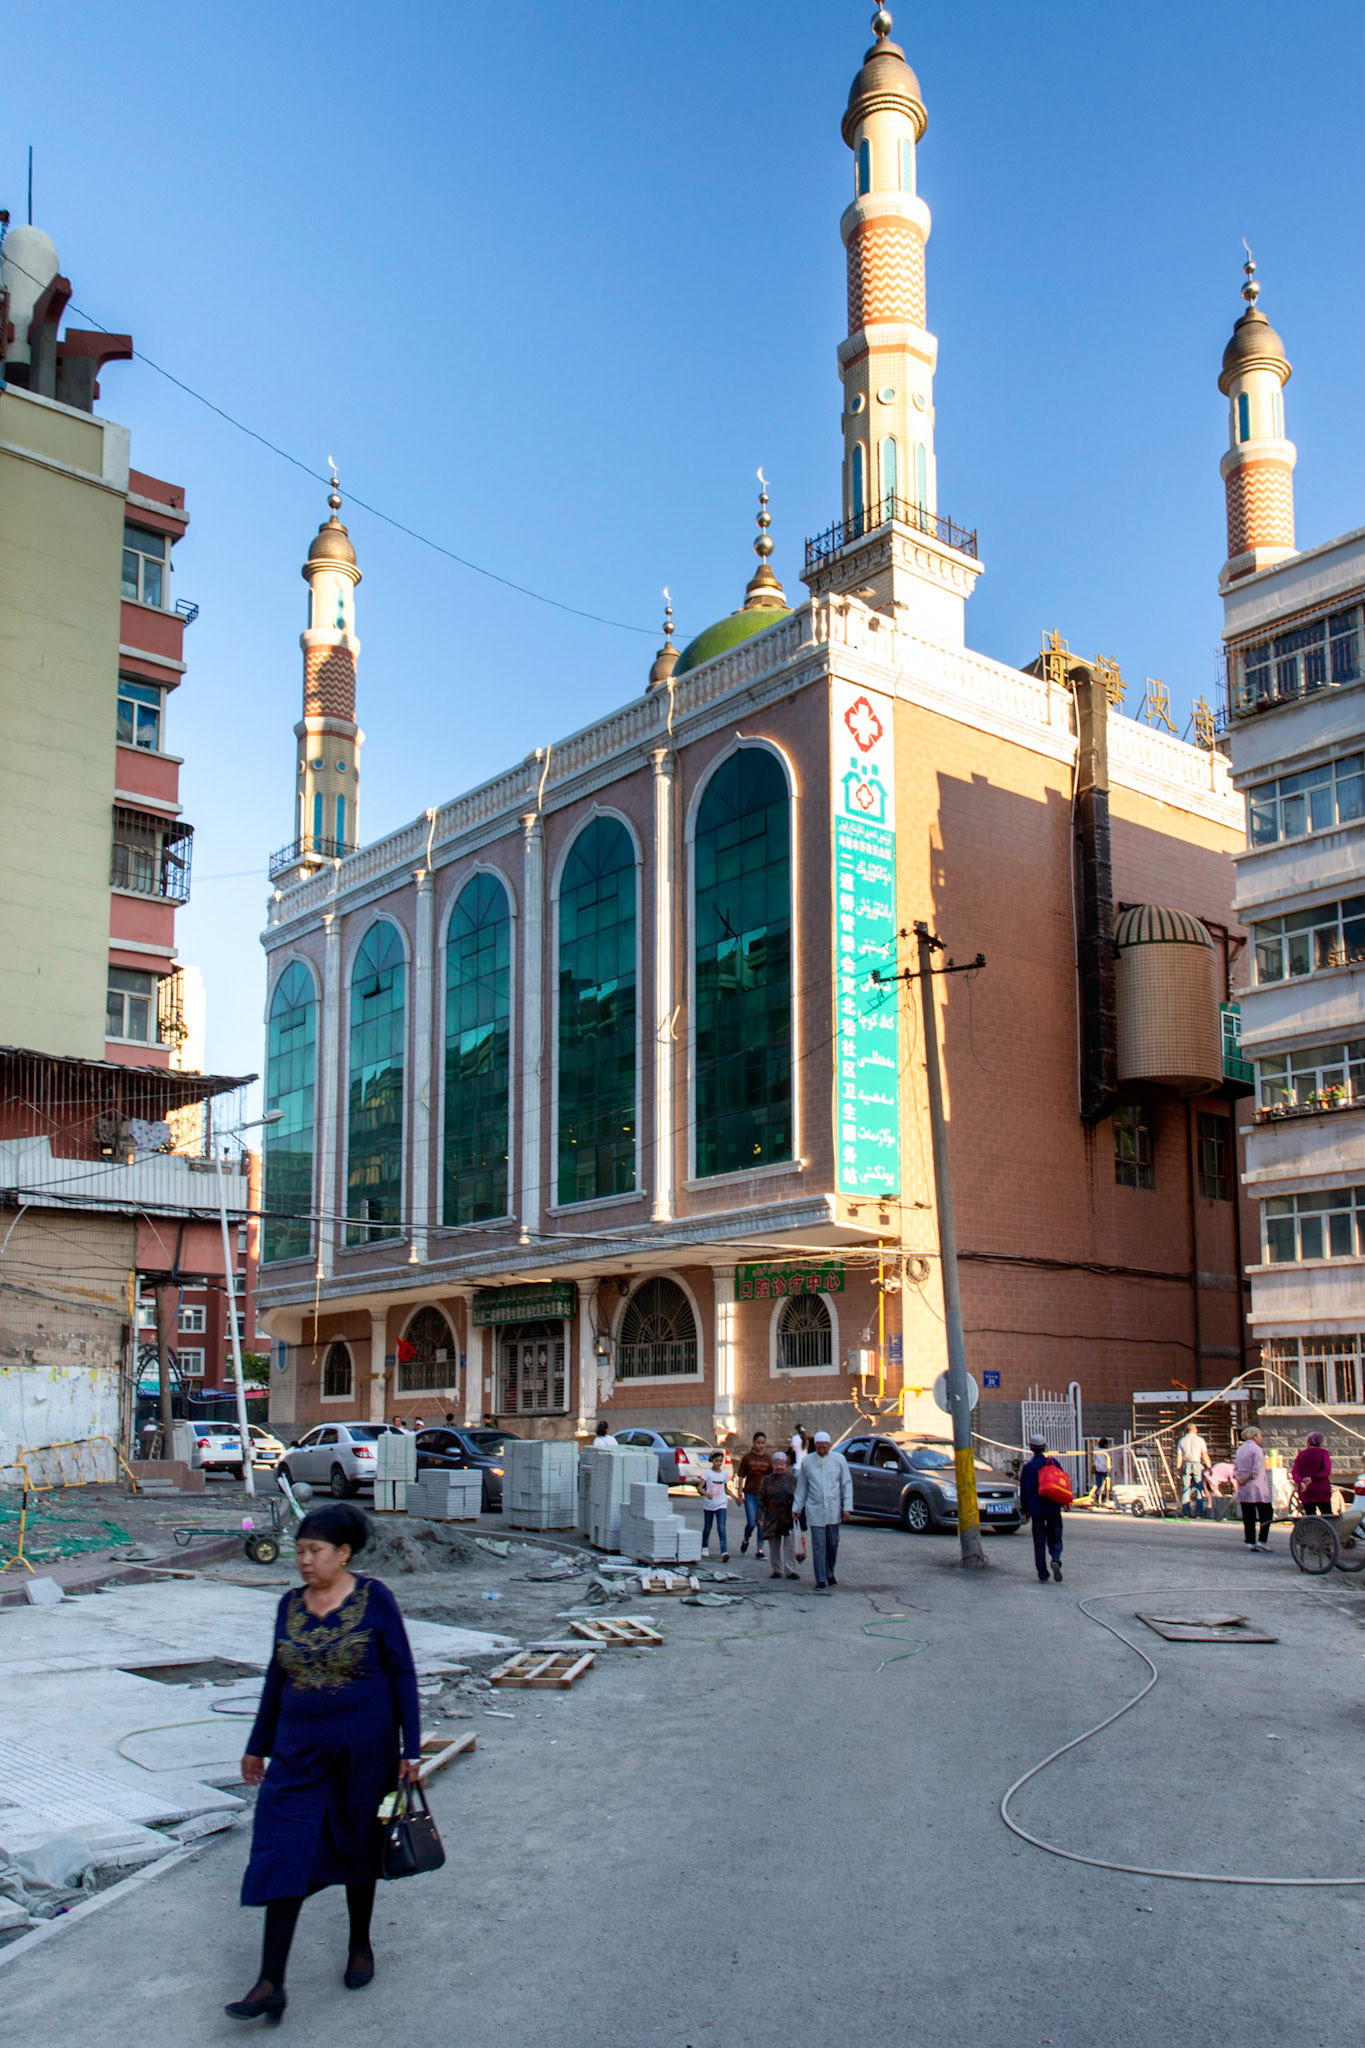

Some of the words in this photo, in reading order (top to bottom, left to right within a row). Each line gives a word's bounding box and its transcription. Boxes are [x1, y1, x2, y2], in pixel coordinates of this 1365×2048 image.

[740, 1272, 840, 1299] 口腔诊疗中心
